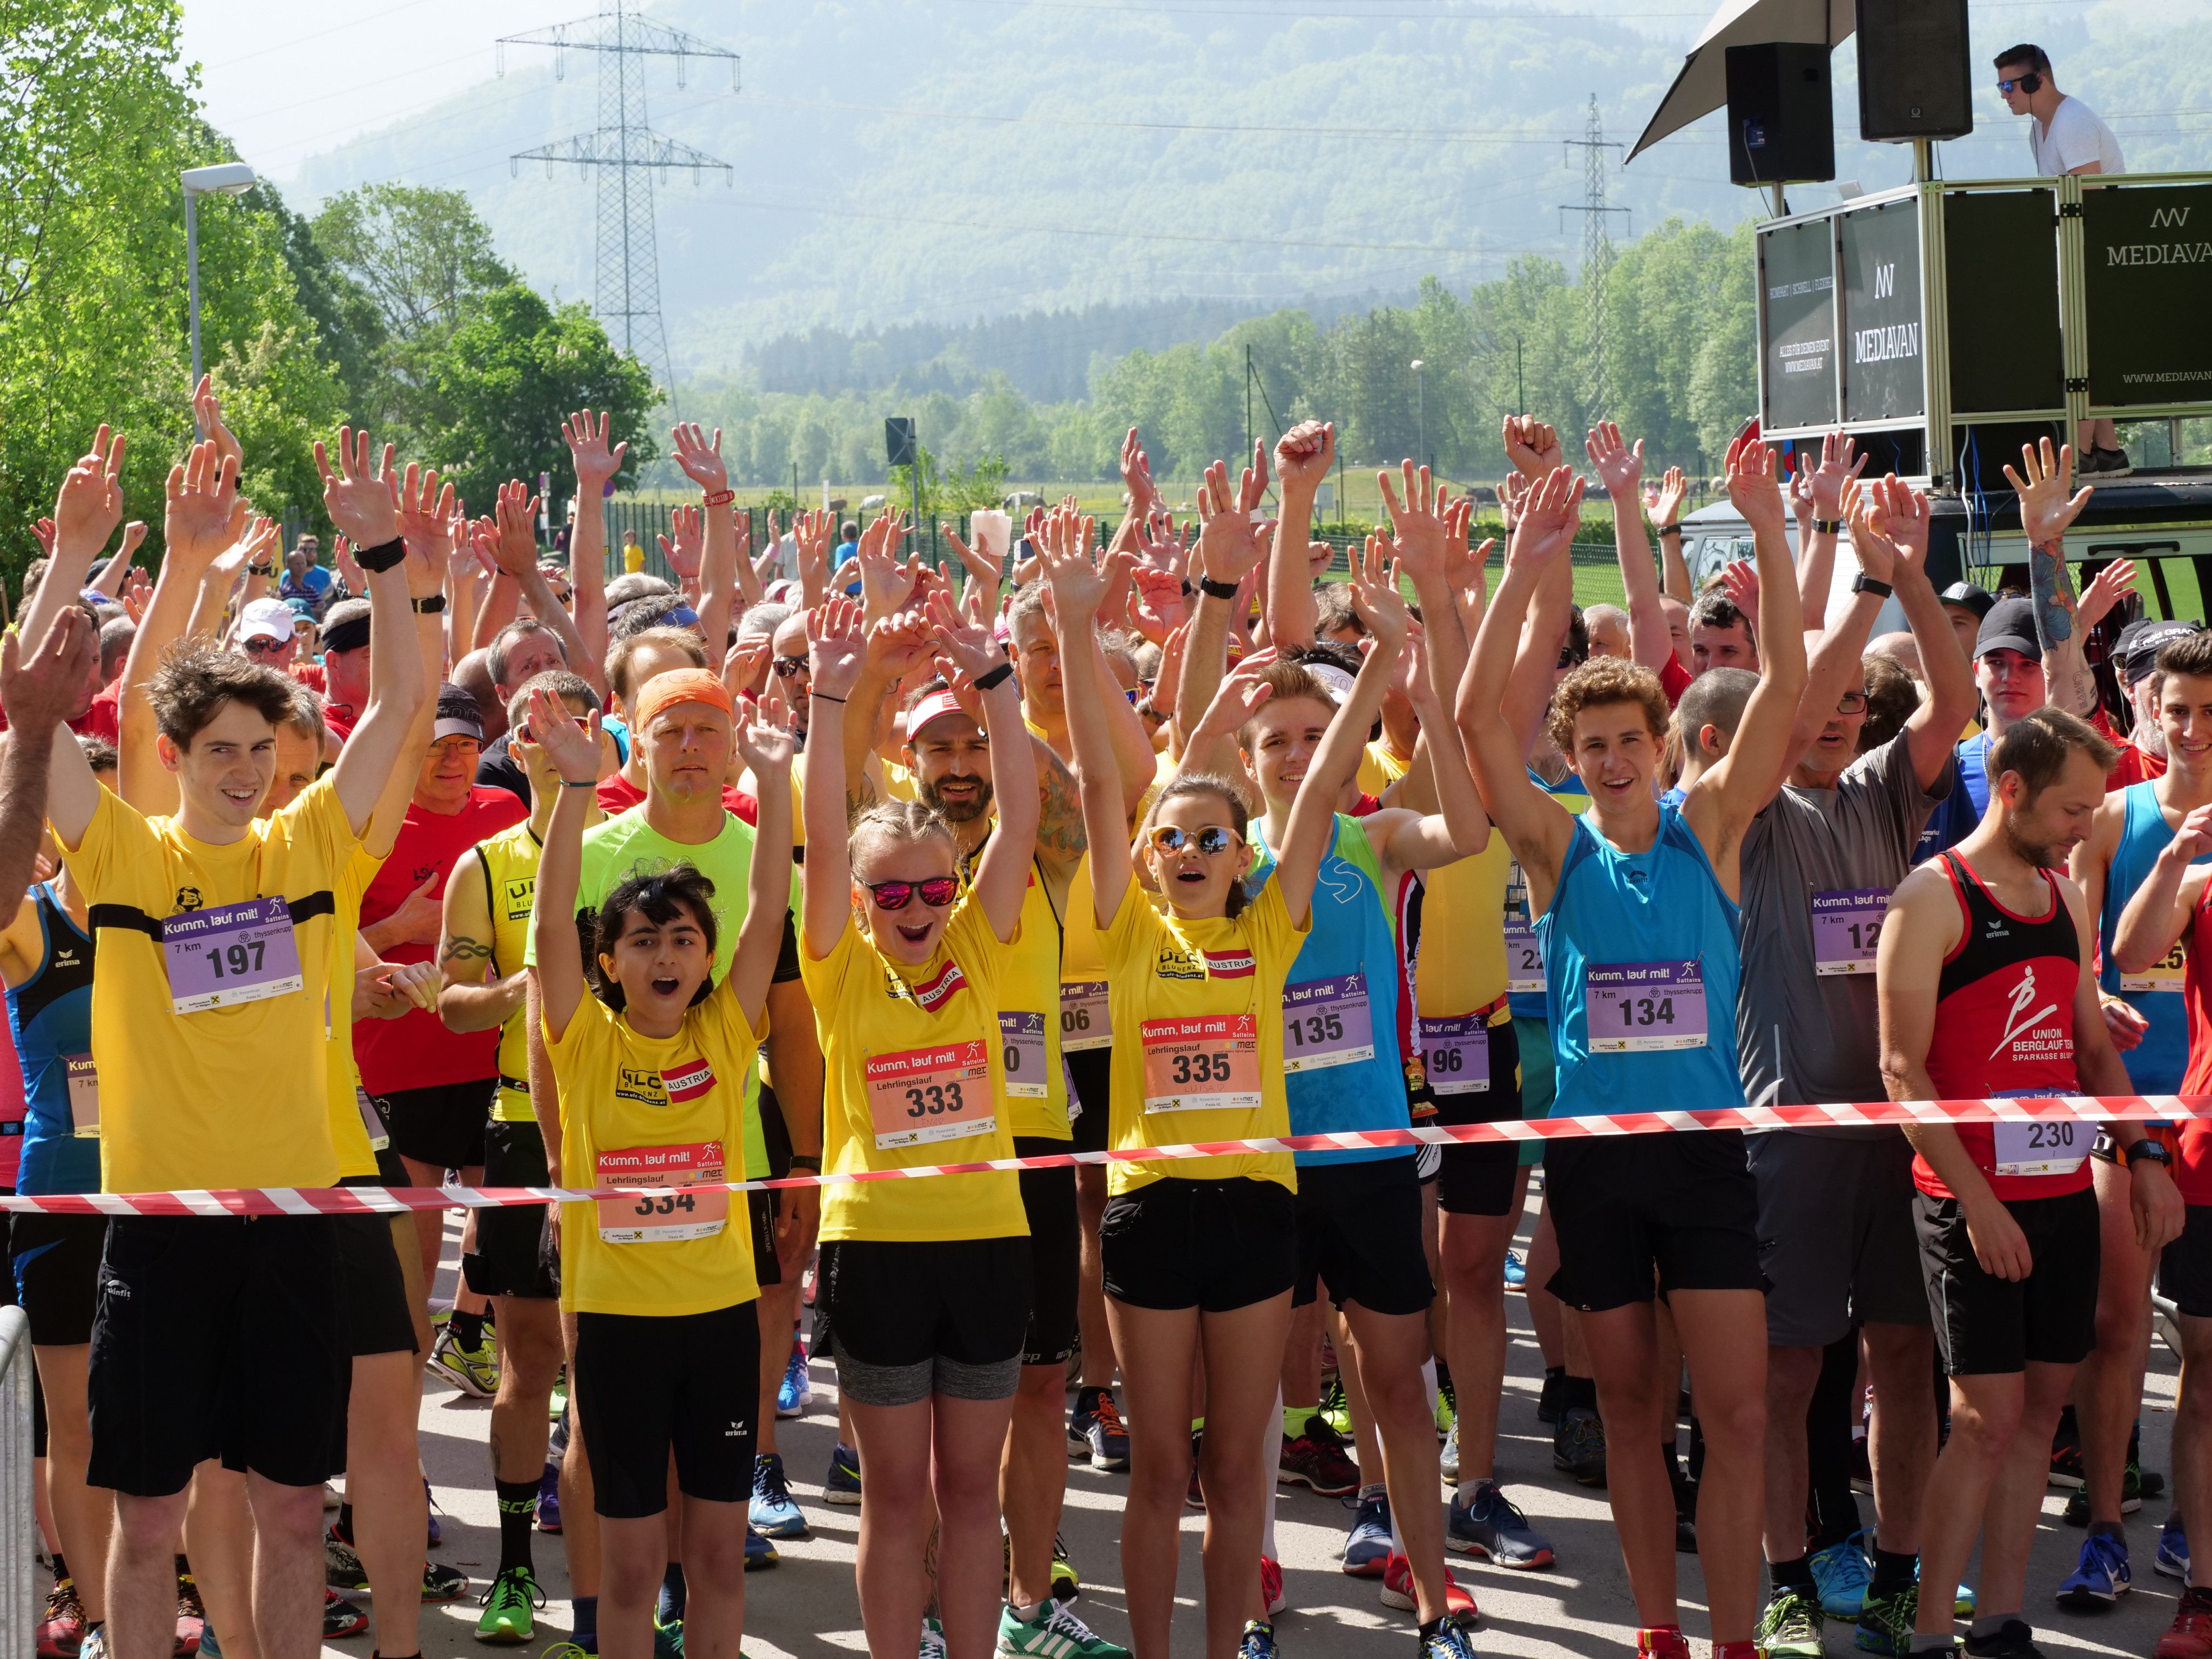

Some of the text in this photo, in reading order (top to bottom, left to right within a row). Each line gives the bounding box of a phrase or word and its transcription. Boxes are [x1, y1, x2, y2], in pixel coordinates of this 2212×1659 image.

[1779, 346, 1792, 358] ALLES
[1800, 341, 1816, 354] DEINEN
[1816, 339, 1829, 352] EVENT
[1855, 322, 1918, 363] MEDIAVAN
[1813, 898, 1852, 907] Kumm,
[1855, 895, 1873, 905] lauf
[165, 908, 259, 935] Kumm, lauf mit!
[265, 913, 289, 923] Satteins
[254, 926, 292, 939] thyssenkrupp
[1986, 930, 2009, 939] erima
[175, 943, 201, 953] 7 km
[55, 959, 80, 968] erima
[206, 940, 266, 979] 197
[1209, 960, 1251, 968] AUSTRIA
[1589, 968, 1669, 981] Kumm, lauf mit!
[923, 971, 959, 1002] AUSTRIA
[1069, 986, 1084, 995] mit!
[1293, 988, 1312, 1000] lauf
[1315, 984, 1334, 996] mit!
[1331, 1001, 1367, 1011] thyssenkrupp
[1619, 998, 1675, 1026] 134
[999, 1018, 1016, 1027] mit!
[1426, 1024, 1442, 1032] lauf
[1444, 1023, 1461, 1031] mit!
[1143, 1022, 1225, 1038] Kumm, lauf mit!
[1289, 1013, 1343, 1046] 135
[2033, 1028, 2062, 1040] UNION
[1011, 1038, 1043, 1046] thyssenkrupp
[1454, 1039, 1486, 1047] thyssenkrupp
[2013, 1040, 2063, 1051] BERGLAUF
[1148, 1044, 1200, 1055] Lehrlingslauf
[868, 1051, 955, 1074] Kumm, lauf mit!
[962, 1058, 985, 1066] Satteins
[1004, 1046, 1020, 1072] 0
[2013, 1053, 2058, 1061] SPARKASSE
[1172, 1054, 1230, 1084] 335
[669, 1070, 710, 1089] AUSTRIA
[876, 1076, 932, 1090] Lehrlingslauf
[625, 1082, 657, 1097] BLENZ
[1185, 1084, 1215, 1093] LUISA
[906, 1083, 963, 1118] 333
[2028, 1121, 2073, 1149] 230
[599, 1152, 690, 1166] Kumm, lauf mit!
[607, 1175, 664, 1185] Lehrlingslauf
[635, 1184, 695, 1216] 334
[108, 1287, 131, 1297] skinfit
